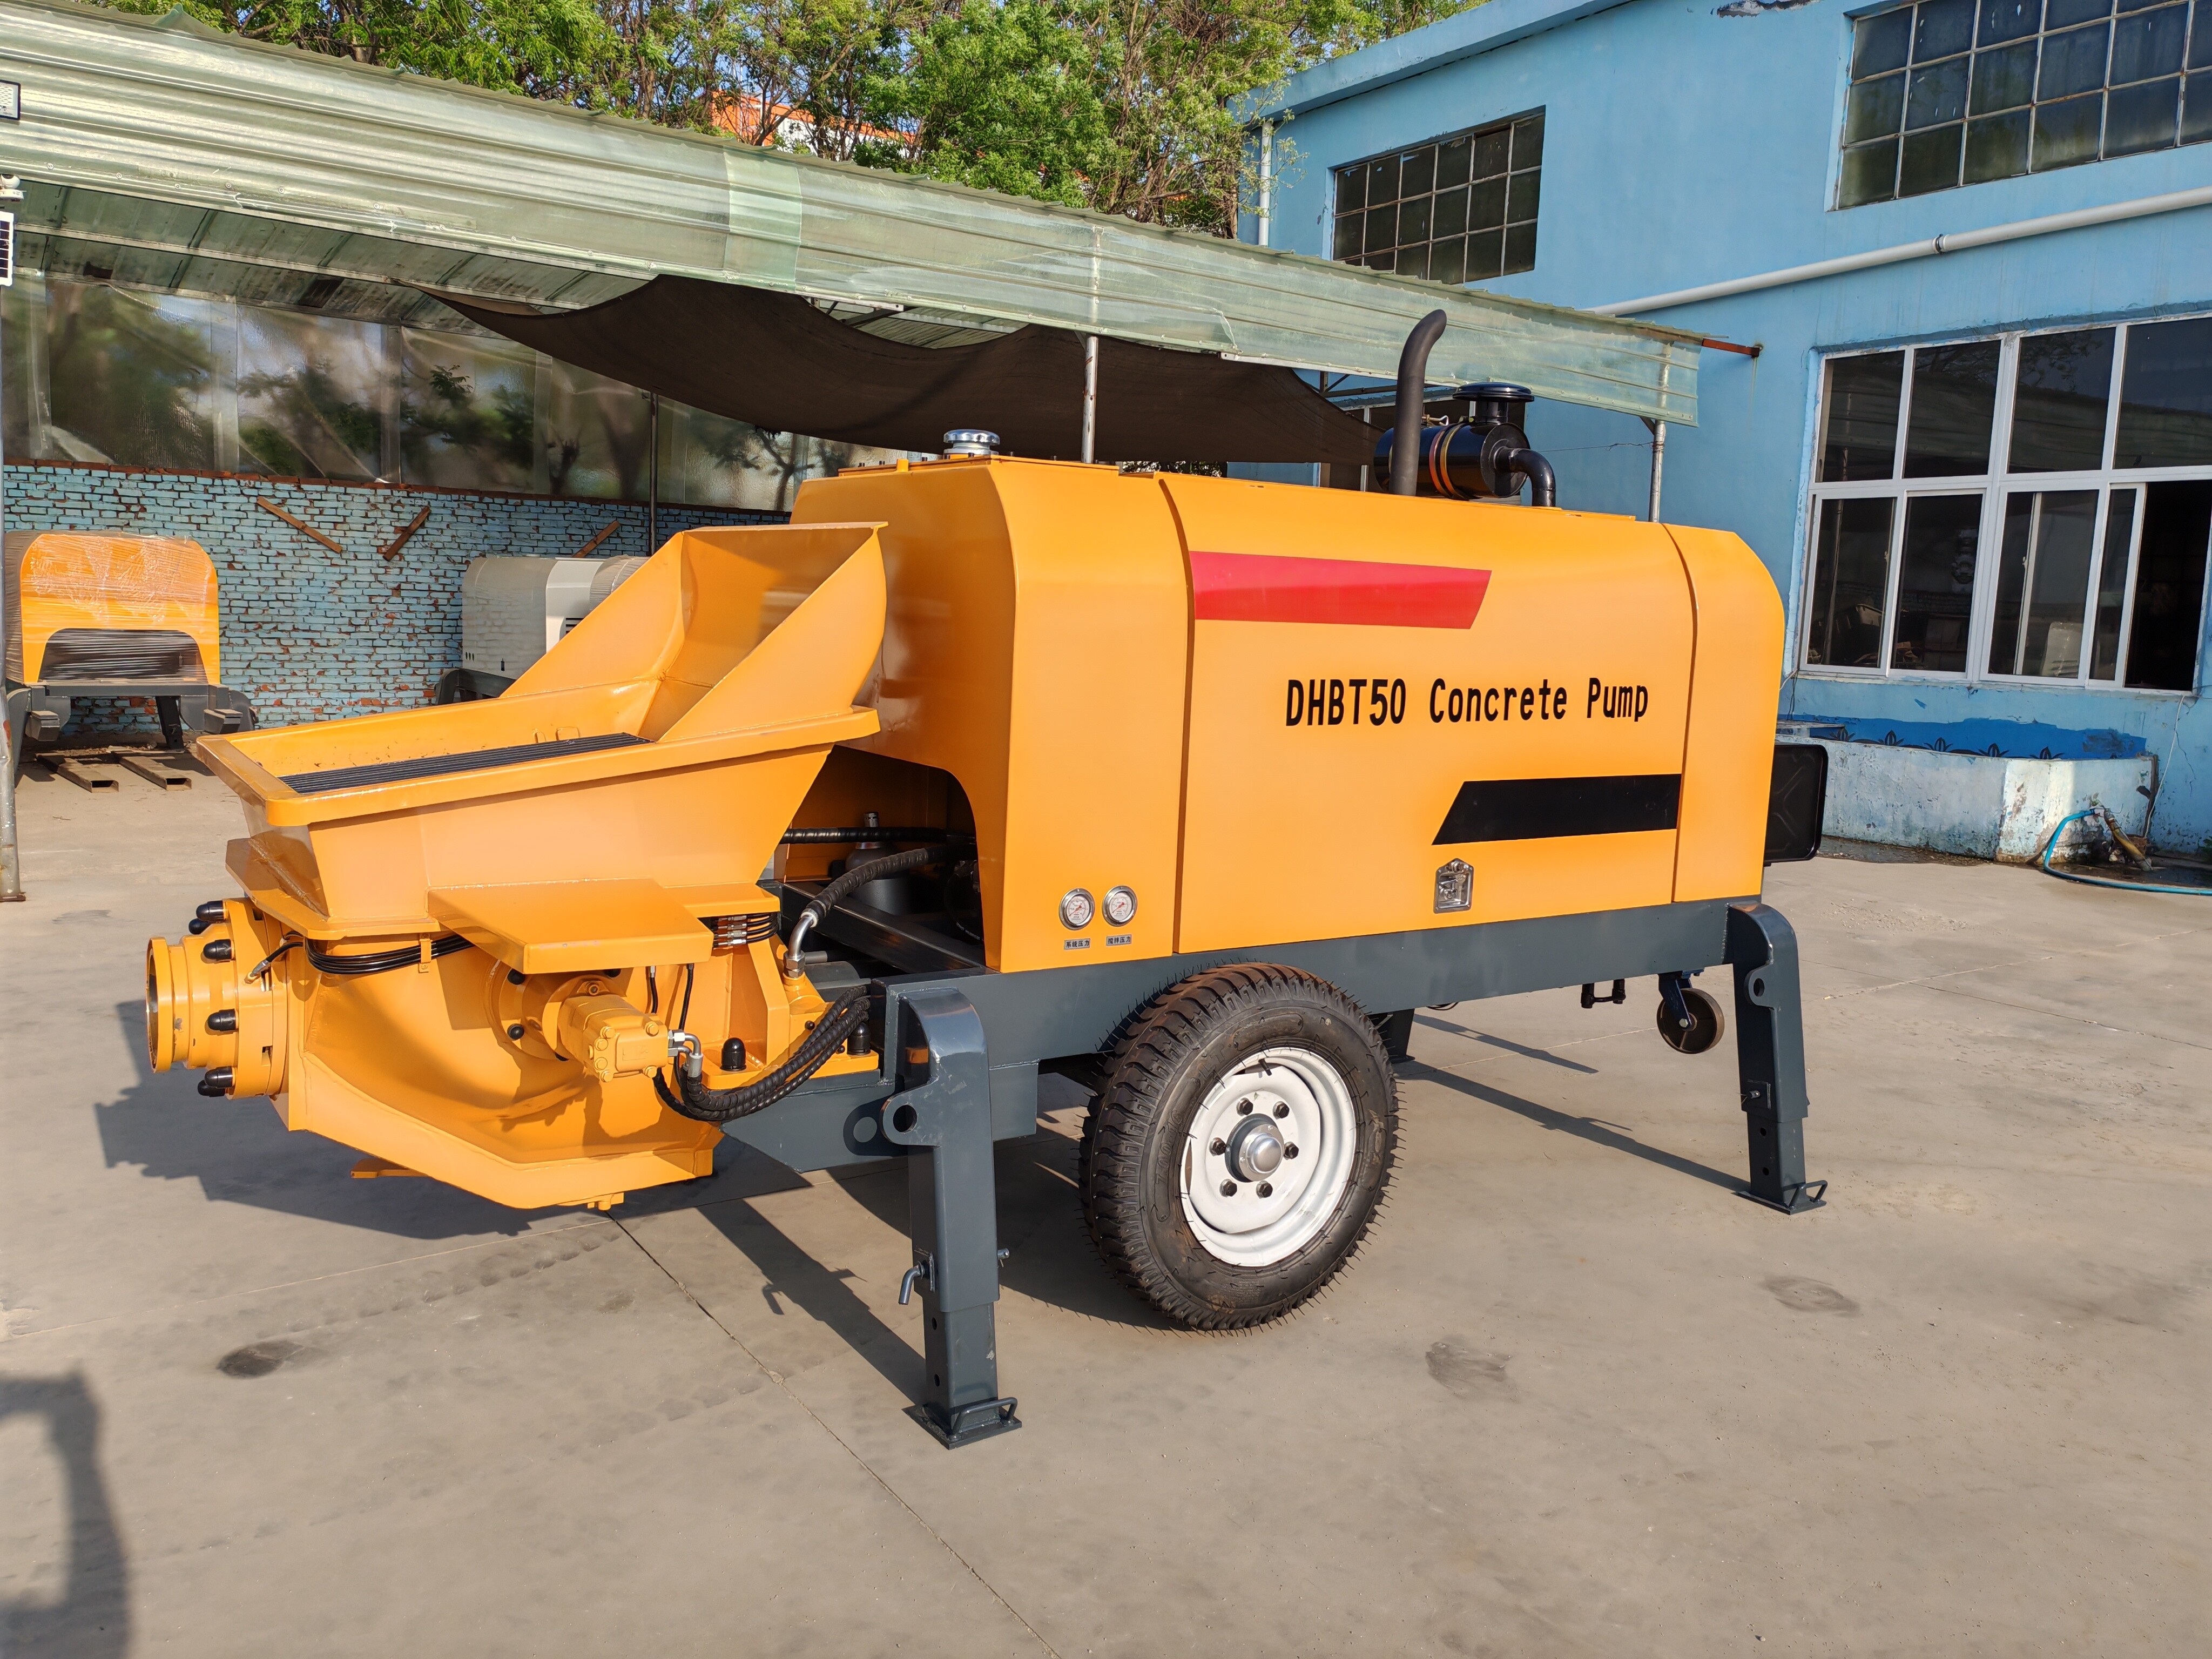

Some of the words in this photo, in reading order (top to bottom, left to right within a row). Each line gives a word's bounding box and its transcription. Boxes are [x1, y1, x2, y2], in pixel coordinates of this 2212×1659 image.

[1286, 678, 1406, 726] DHBT50
[1429, 678, 1567, 723] Concrete
[1587, 677, 1648, 722] Pump
[1066, 940, 1089, 948] 系统压力
[1108, 936, 1131, 944] 搅拌压力
